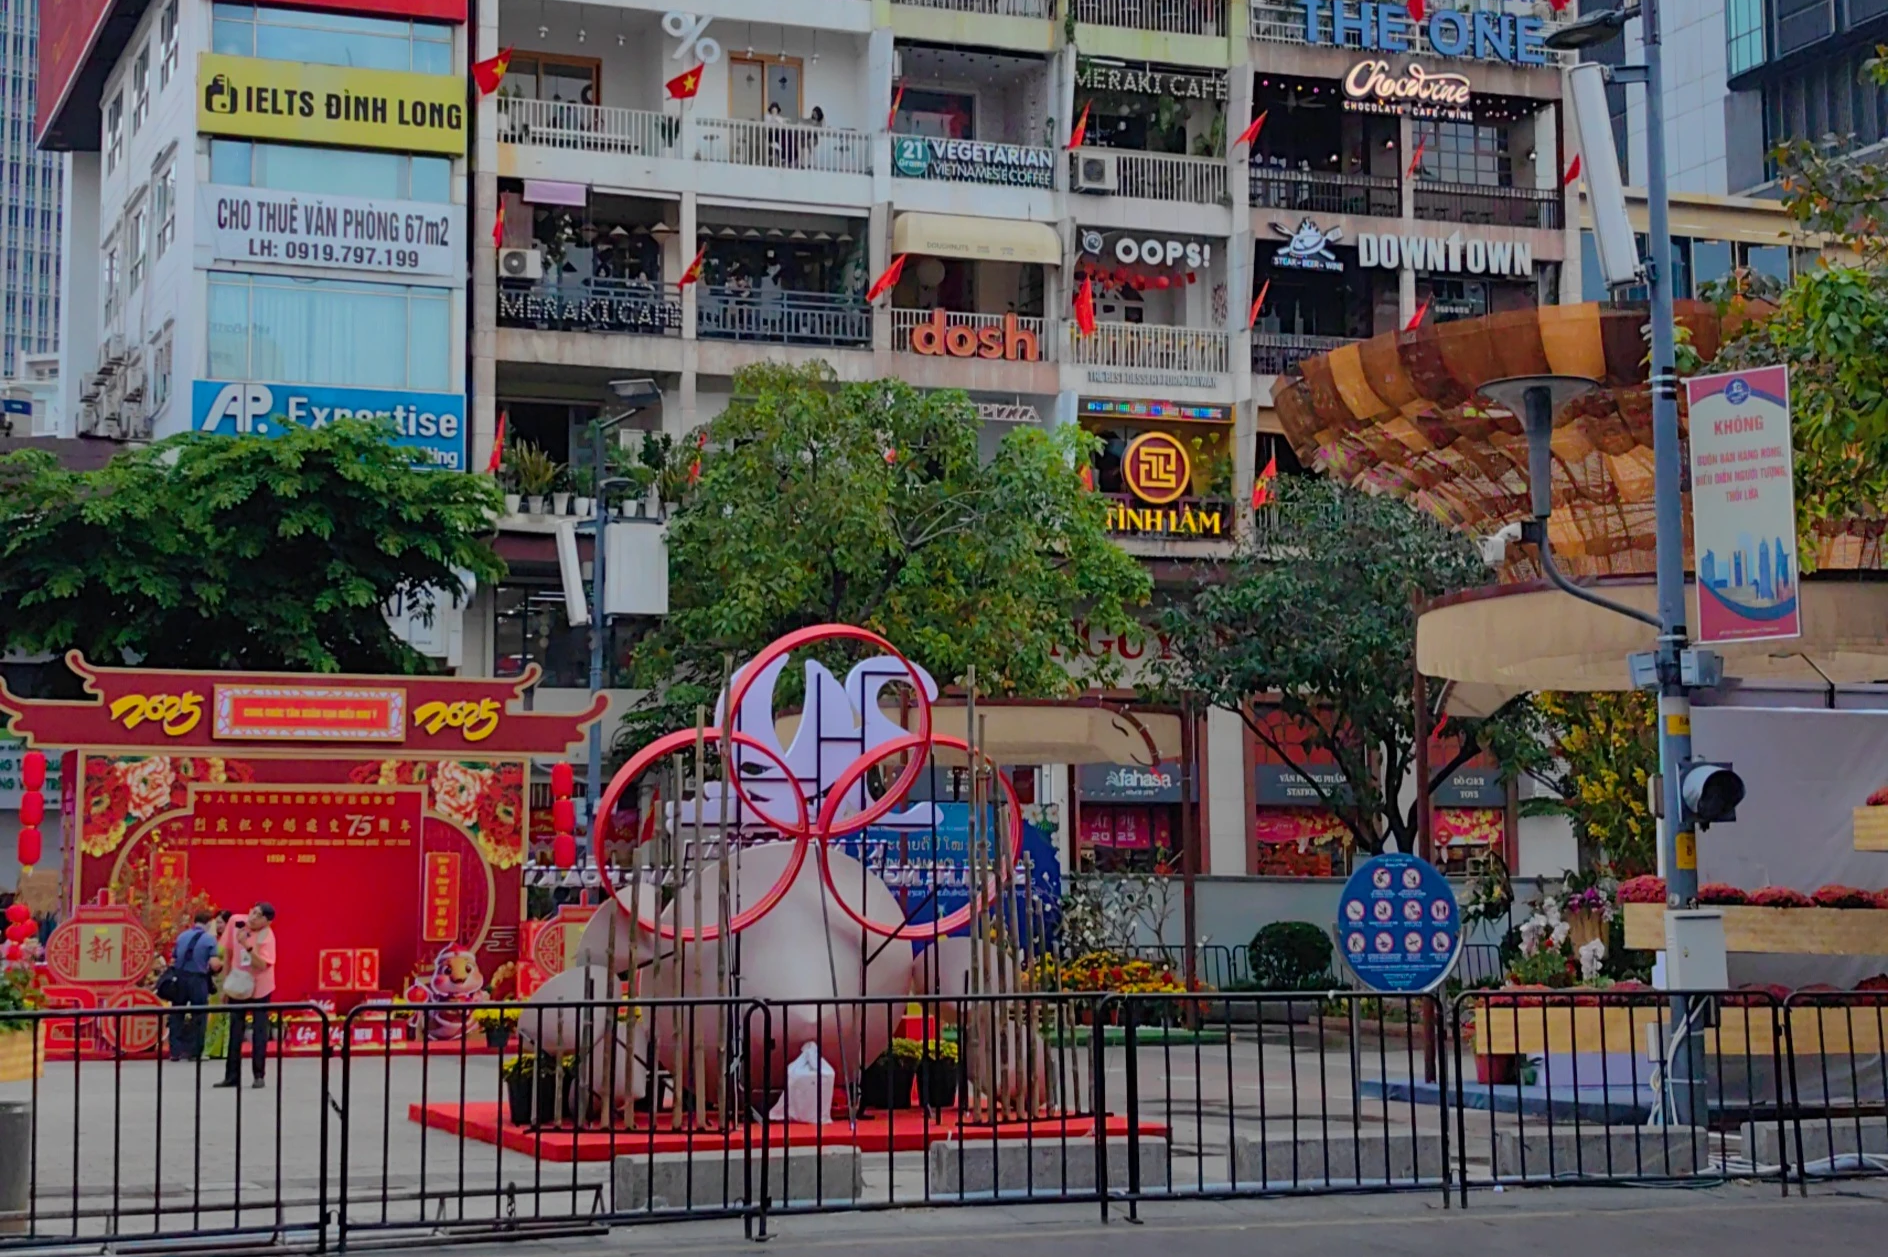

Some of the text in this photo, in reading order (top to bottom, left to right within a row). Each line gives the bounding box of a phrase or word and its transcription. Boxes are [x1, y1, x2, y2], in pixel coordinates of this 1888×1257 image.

[1428, 9, 1547, 63] ONE
[1074, 67, 1162, 95] MERAKI
[246, 85, 462, 130] IELTS ĐÌNH LONG
[899, 158, 927, 169] Grams
[902, 140, 923, 159] 21
[930, 140, 1054, 168] VEGETARIAN
[932, 161, 1051, 186] VIETNAMESE COFFEE
[217, 197, 449, 247] CHO THUÊ VĂN PHÒNG 67m2
[249, 238, 420, 268] LH: 0919.797.199
[1116, 237, 1211, 268] OOPS!
[912, 307, 1040, 362] dosh
[1713, 414, 1764, 436] KHÔNG
[1119, 768, 1171, 787] fahasa
